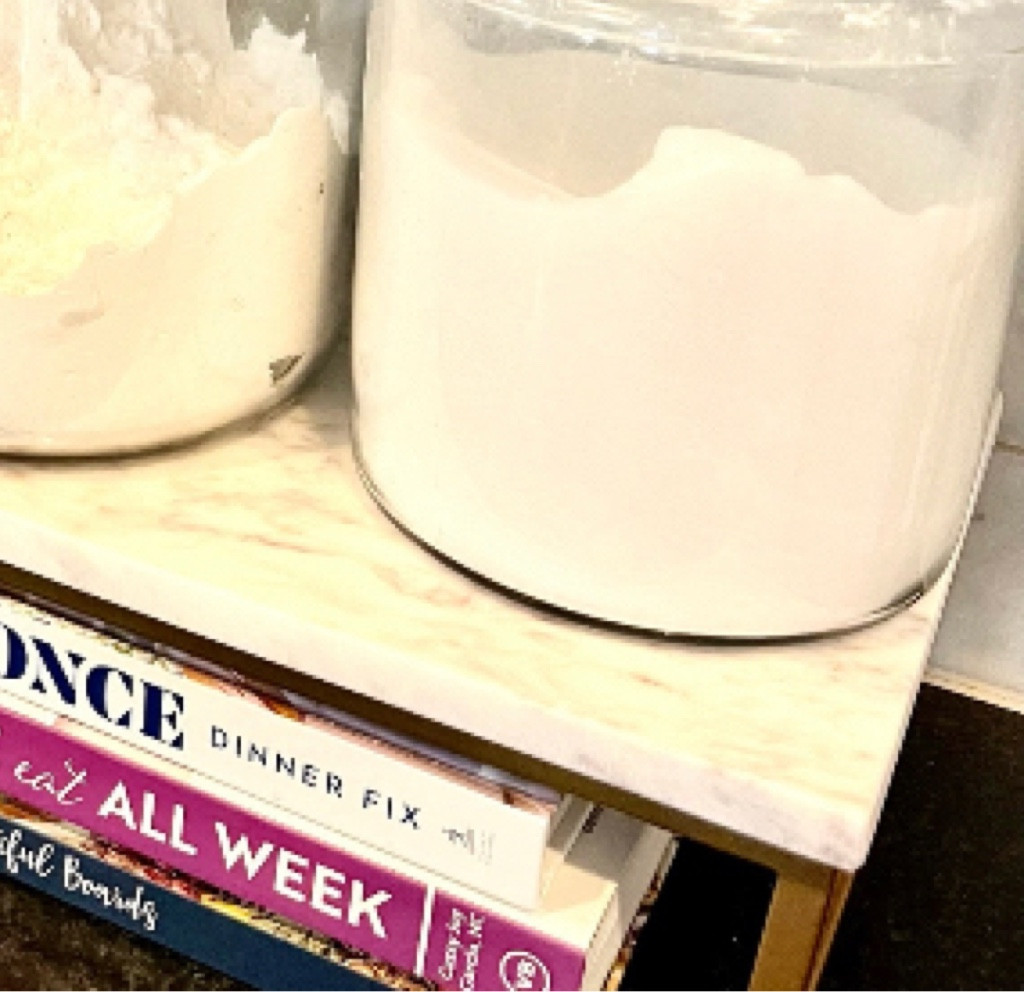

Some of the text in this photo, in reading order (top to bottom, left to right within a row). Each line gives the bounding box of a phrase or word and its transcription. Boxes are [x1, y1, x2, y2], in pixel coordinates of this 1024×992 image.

[211, 725, 343, 799] DINNER
[362, 789, 421, 831] FIX
[14, 758, 87, 806] eat
[97, 780, 198, 856] ALL
[215, 821, 392, 939] WEEK
[63, 856, 158, 932] Boards
